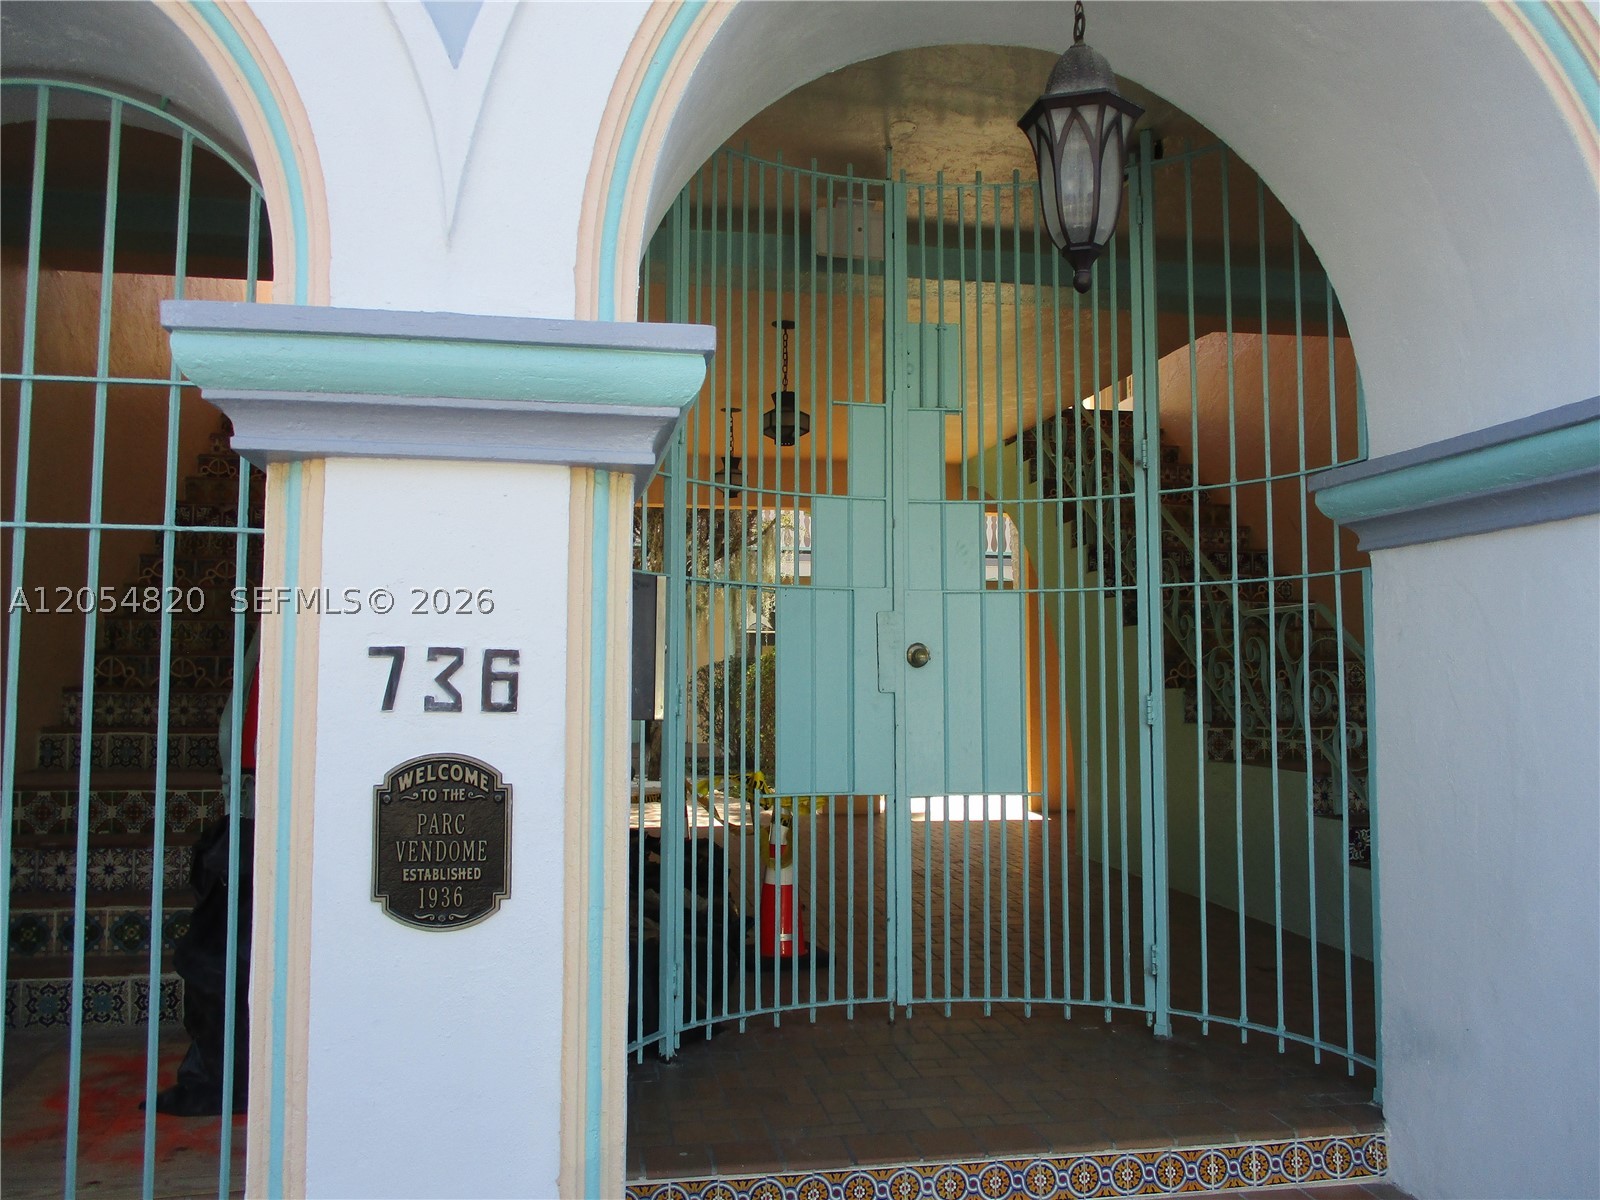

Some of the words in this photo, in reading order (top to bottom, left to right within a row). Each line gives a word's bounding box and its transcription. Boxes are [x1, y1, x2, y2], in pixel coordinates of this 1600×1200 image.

[368, 646, 520, 713] 736
[398, 763, 490, 792] WELCOME
[420, 788, 438, 802] TO
[442, 788, 466, 802] THE
[417, 813, 466, 836] PARC
[396, 840, 488, 863] VENDOME
[403, 867, 482, 882] ESTABLISHED
[419, 886, 463, 909] 1936
